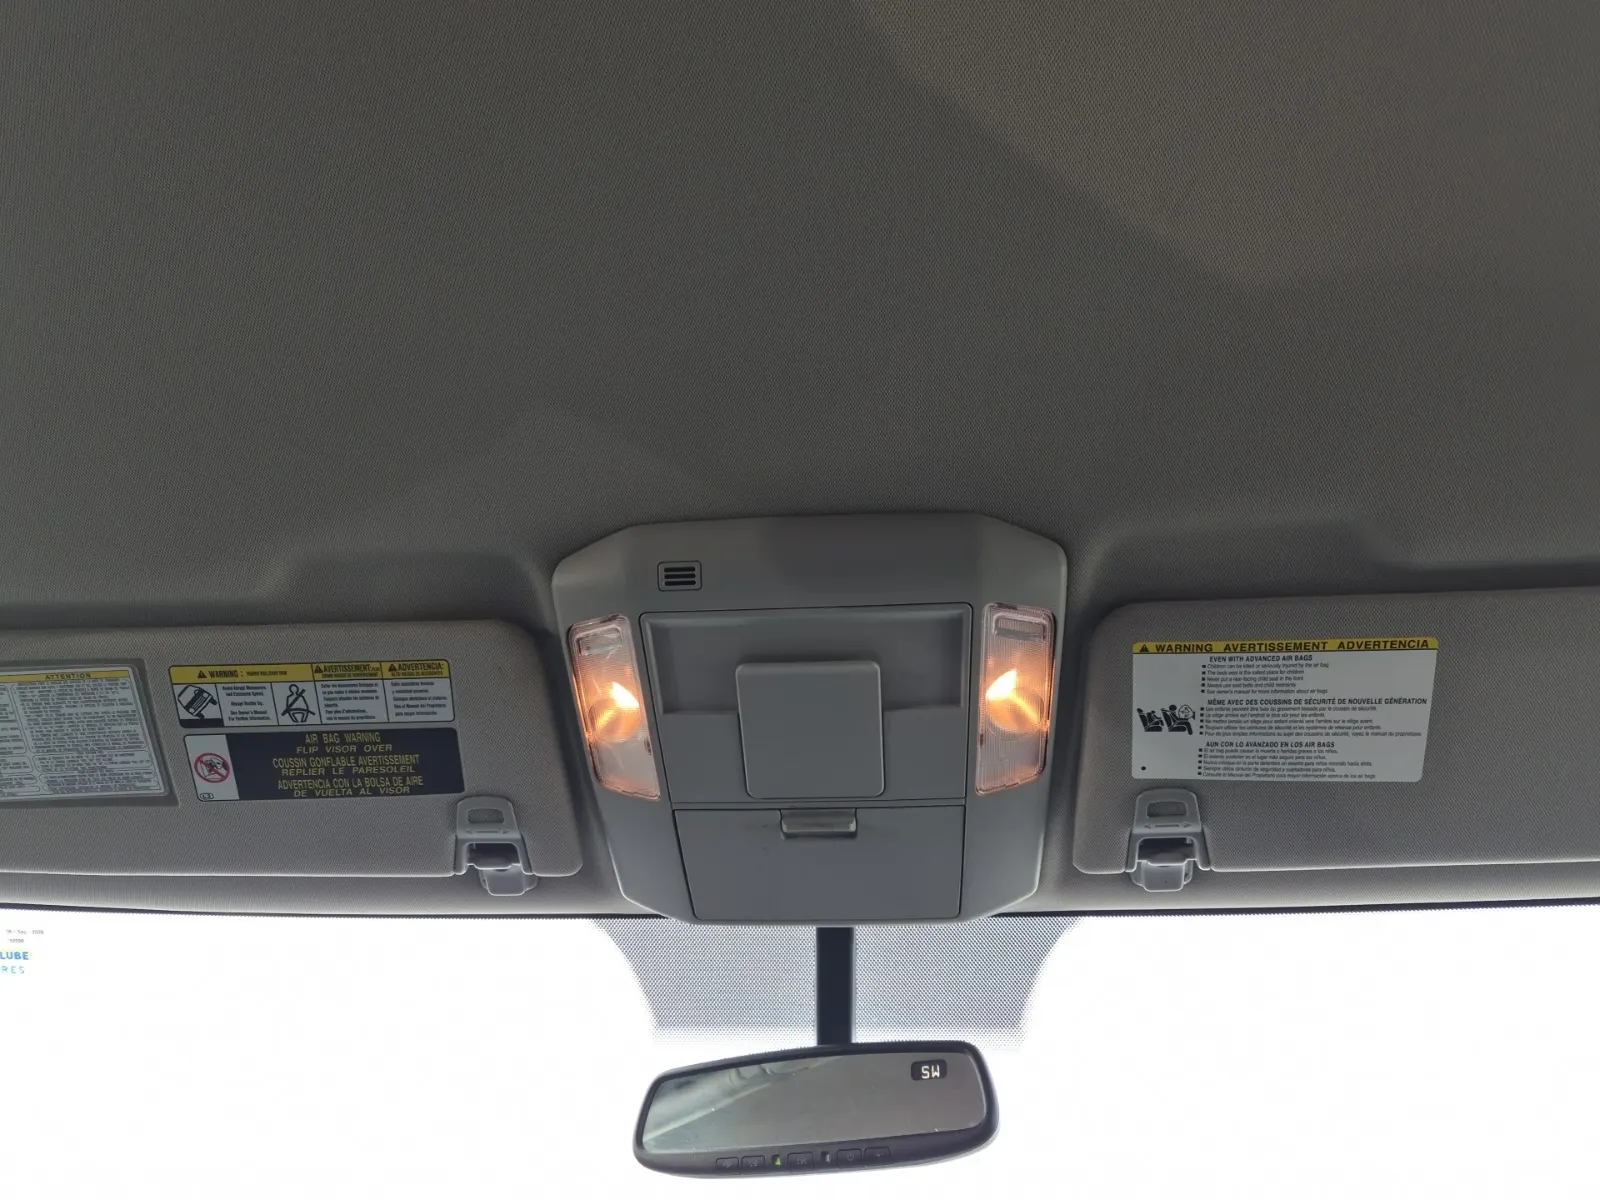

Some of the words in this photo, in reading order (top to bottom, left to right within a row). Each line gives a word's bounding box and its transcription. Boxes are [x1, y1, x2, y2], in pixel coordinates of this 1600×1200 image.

[1155, 643, 1213, 653] WARNING
[1223, 641, 1328, 651] AVERTISSEMENT
[1337, 639, 1429, 650] ADVERTENCIA
[209, 670, 238, 679] WARNING
[305, 734, 319, 744] AIR
[323, 734, 340, 743] BAG
[344, 733, 381, 743] WARNING
[273, 757, 307, 768] COUSSIN
[310, 756, 355, 767] GONFLABLE
[358, 755, 420, 766] AVERTISSEMENT
[352, 767, 415, 775] PARESOLEIL
[278, 779, 331, 789] ADVERTENCIA
[333, 778, 350, 788] CON
[352, 778, 362, 787] LA
[365, 777, 390, 787] BOLSA
[392, 777, 404, 787] DE
[406, 777, 424, 786] AIRE
[0, 952, 29, 960] LUBE
[922, 1064, 940, 1079] SW
